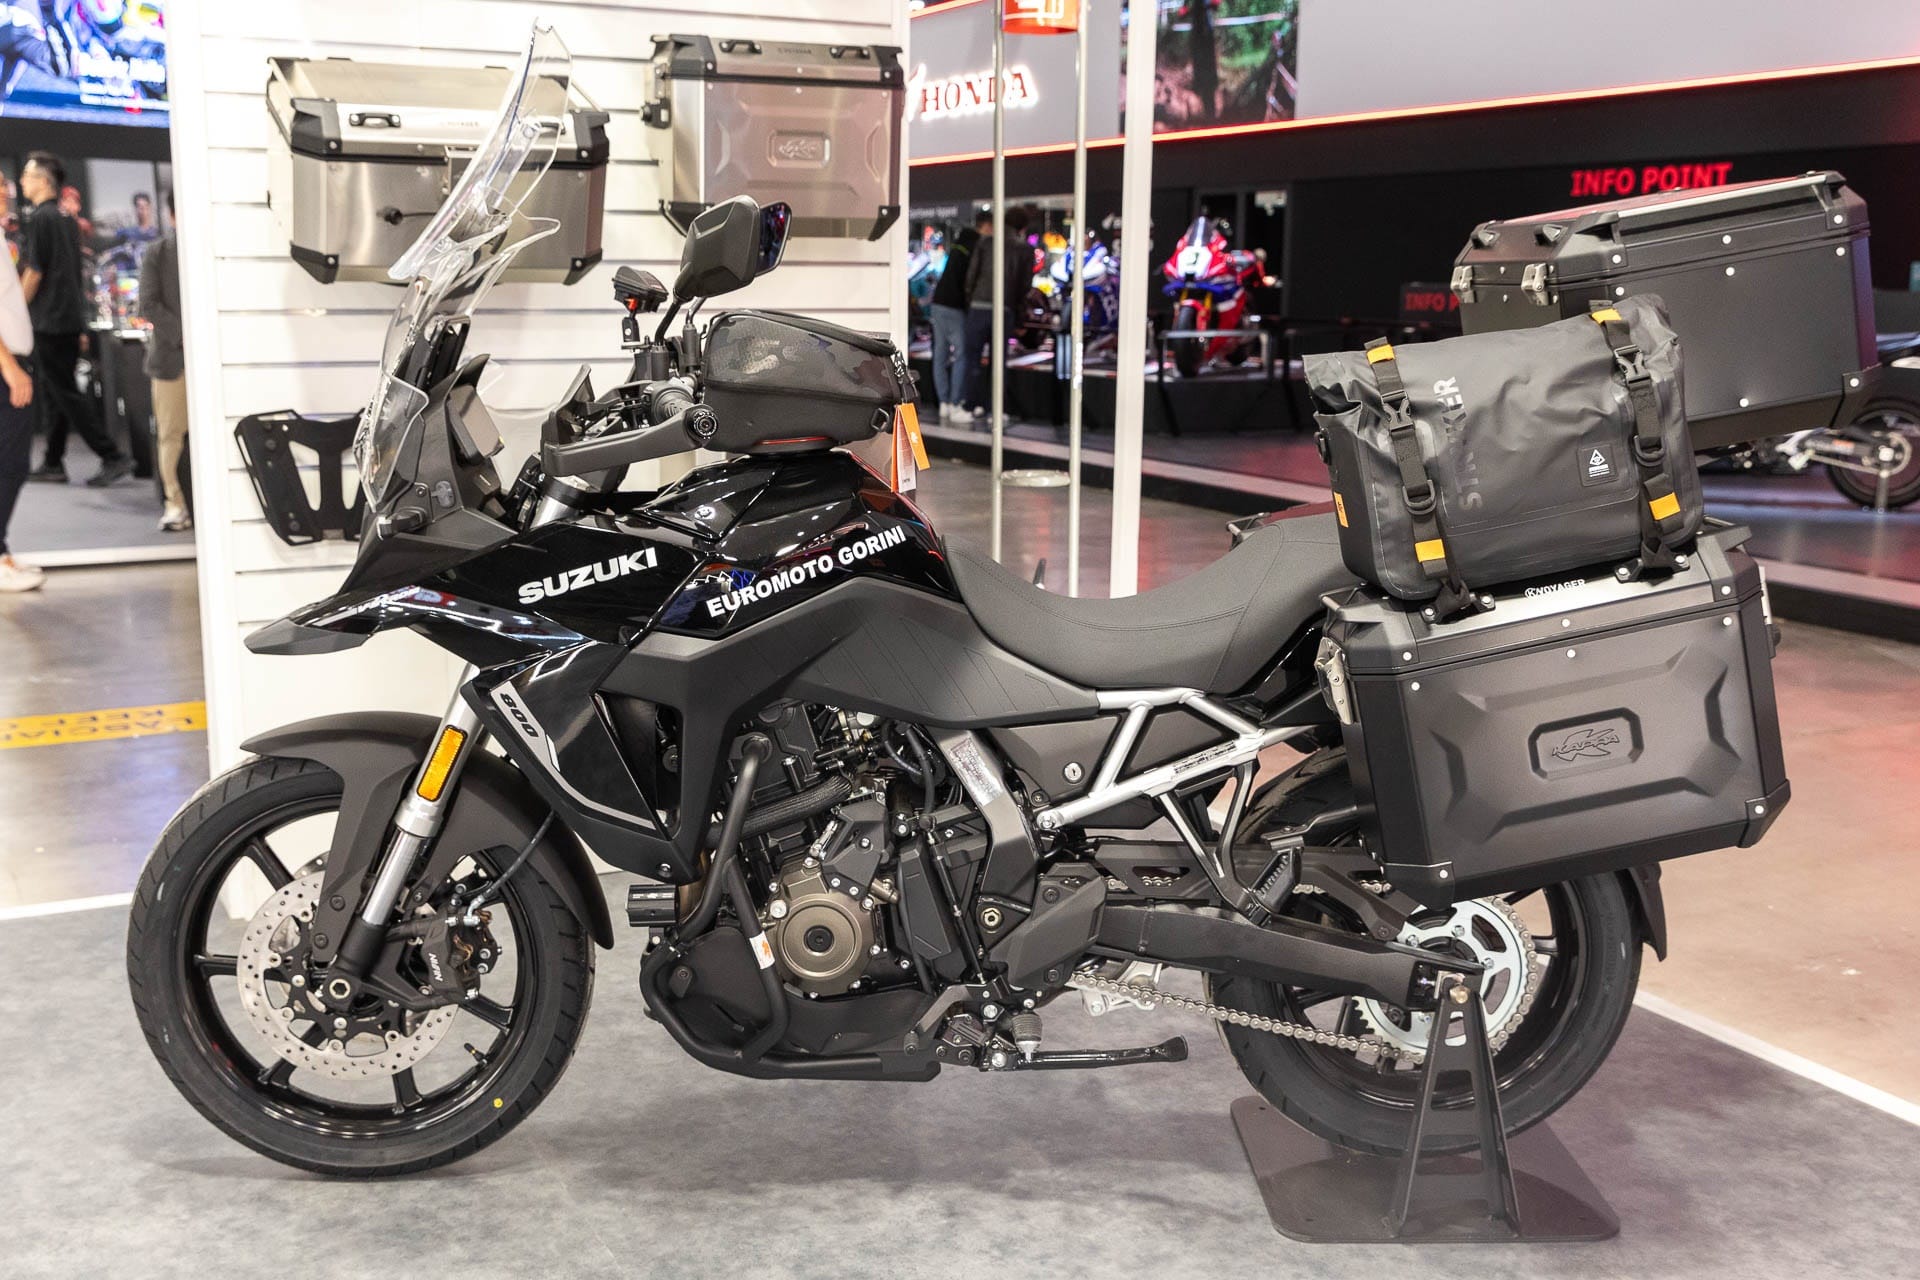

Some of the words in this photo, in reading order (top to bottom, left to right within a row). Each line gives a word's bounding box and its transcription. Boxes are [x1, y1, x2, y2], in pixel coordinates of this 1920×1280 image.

[919, 72, 1029, 113] HONDA
[1570, 167, 1636, 197] INFO
[1640, 162, 1733, 194] POINT
[1405, 292, 1445, 312] INFO
[518, 547, 658, 604] SUZUKI
[706, 554, 833, 618] EUROMOTO
[838, 525, 906, 565] GORINI
[500, 693, 539, 738] 800
